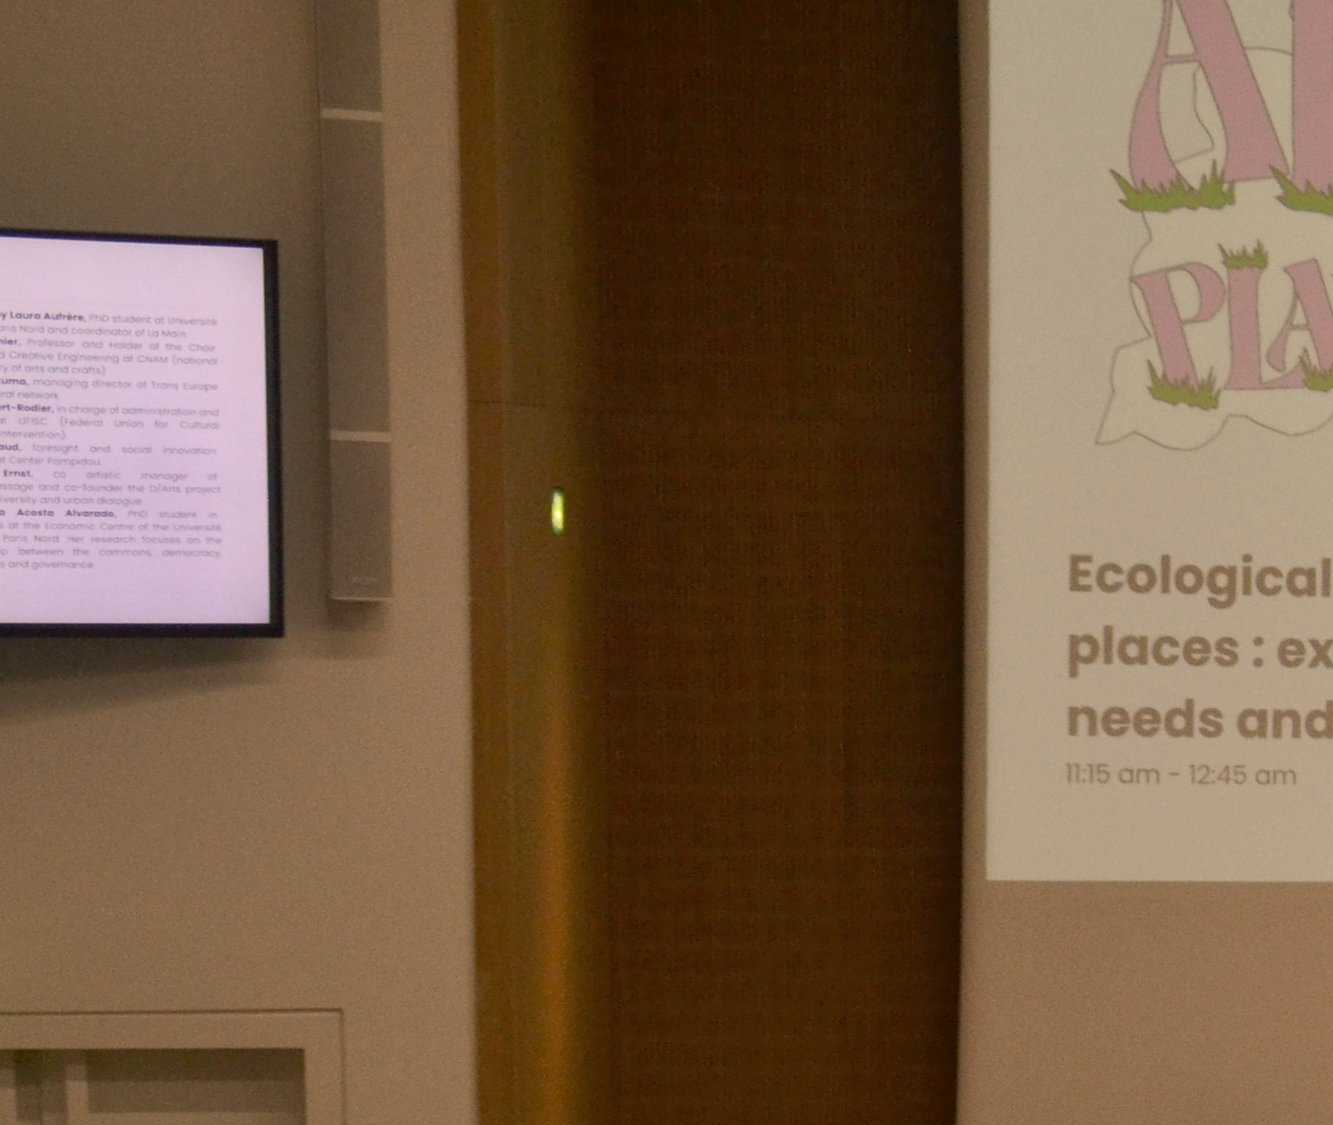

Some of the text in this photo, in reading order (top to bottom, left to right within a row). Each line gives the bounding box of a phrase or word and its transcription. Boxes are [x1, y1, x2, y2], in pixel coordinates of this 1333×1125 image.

[10, 311, 41, 320] Laura
[17, 508, 55, 517] Acosta
[1068, 553, 1332, 609] Ecological
[1068, 625, 1239, 679] places
[1252, 636, 1265, 668] :
[1067, 698, 1224, 738] needs
[1066, 762, 1111, 785] 11:15
[1117, 767, 1161, 784] am
[1189, 763, 1248, 786] 12:45
[1254, 768, 1298, 786] am
